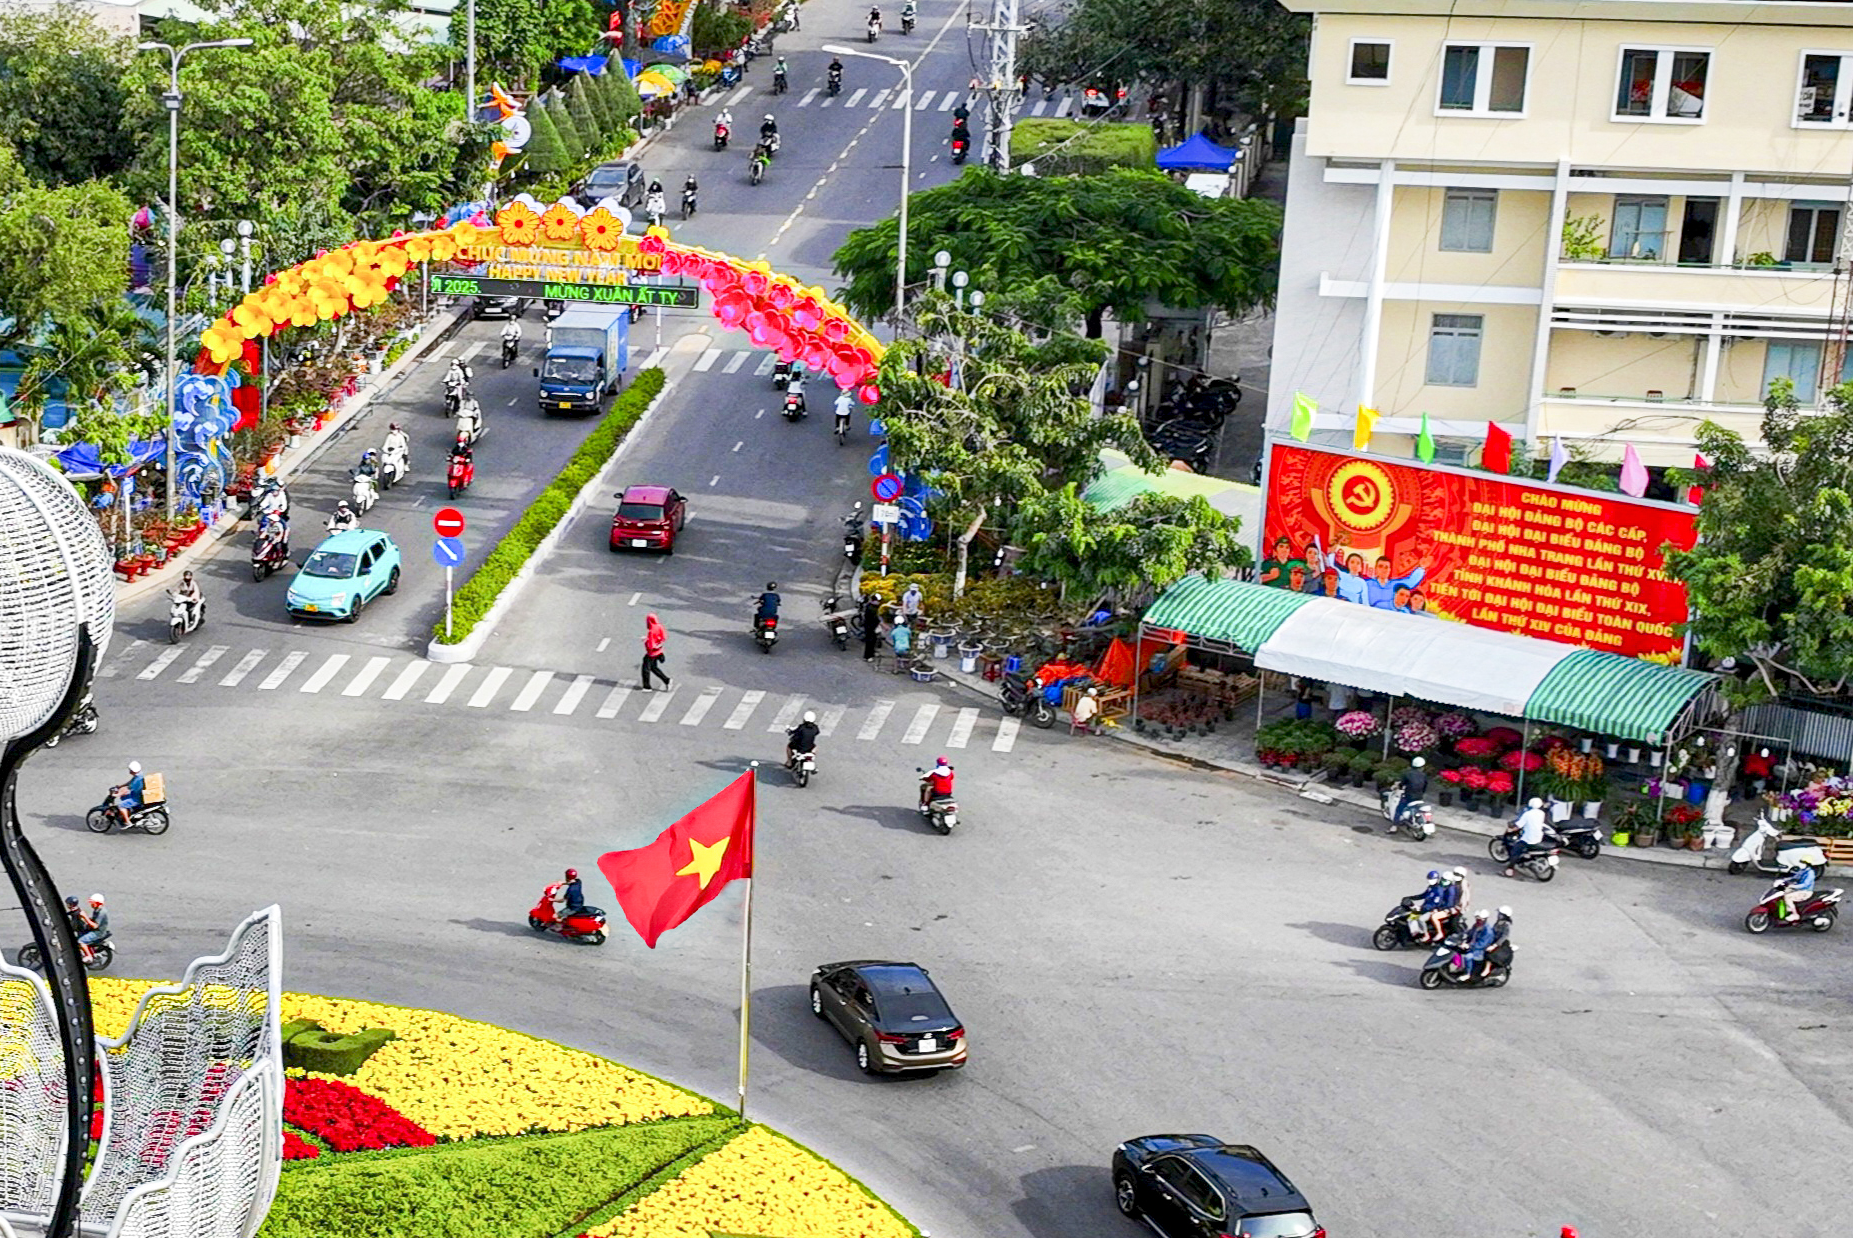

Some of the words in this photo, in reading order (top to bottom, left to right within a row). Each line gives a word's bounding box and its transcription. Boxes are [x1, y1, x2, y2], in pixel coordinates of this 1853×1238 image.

[445, 280, 482, 294] 2025.
[544, 283, 589, 299] MỪNG
[593, 286, 634, 302] XUÂN
[637, 286, 656, 304] ẤT
[488, 263, 541, 280] HAPPY
[546, 268, 581, 284] NEW
[587, 270, 628, 286] YEAR
[1473, 502, 1495, 517] ĐẠI
[1499, 506, 1521, 521] HỘI
[1524, 510, 1561, 527] ĐẢNG
[1565, 517, 1584, 532] BỘ
[1587, 521, 1615, 536] CÁC
[1618, 526, 1647, 543] CẤP,
[1521, 492, 1557, 508] CHÀO
[1561, 498, 1603, 516] MỪNG
[1433, 530, 1476, 548] THÀNH
[1479, 538, 1506, 553] PHỐ
[1508, 544, 1536, 559] NHA
[1540, 549, 1583, 567] TRANG
[1587, 556, 1614, 572] LẦN
[1617, 563, 1645, 578] THỨ
[1472, 520, 1495, 534] ĐẠI
[1498, 524, 1521, 539] HỘI
[1523, 529, 1547, 543] ĐẠI
[1584, 539, 1622, 556] ĐẢNG
[1625, 546, 1645, 561] BỘ
[1468, 554, 1491, 569] ĐẠI
[1494, 559, 1517, 574] HỘI
[1519, 564, 1543, 578] ĐẠI
[1579, 573, 1618, 592] ĐẢNG
[1621, 582, 1640, 597] BỘ
[1486, 575, 1532, 593] KHÁNH
[1565, 589, 1592, 604] LẦN
[1595, 595, 1623, 610] THỨ
[1624, 600, 1651, 617] XIX,
[1430, 581, 1458, 597] TIẾN
[1462, 588, 1482, 602] TỚI
[1485, 593, 1507, 608] ĐẠI
[1510, 597, 1533, 612] HỘI
[1536, 602, 1559, 617] ĐẠI
[1596, 613, 1632, 630] TOÀN
[1636, 621, 1673, 638] QUỐC
[1472, 606, 1498, 622] LẦN
[1501, 613, 1528, 628] THỨ
[1529, 619, 1551, 632] XIV
[1554, 623, 1581, 638] CỦA
[1584, 629, 1623, 647] ĐẢNG
